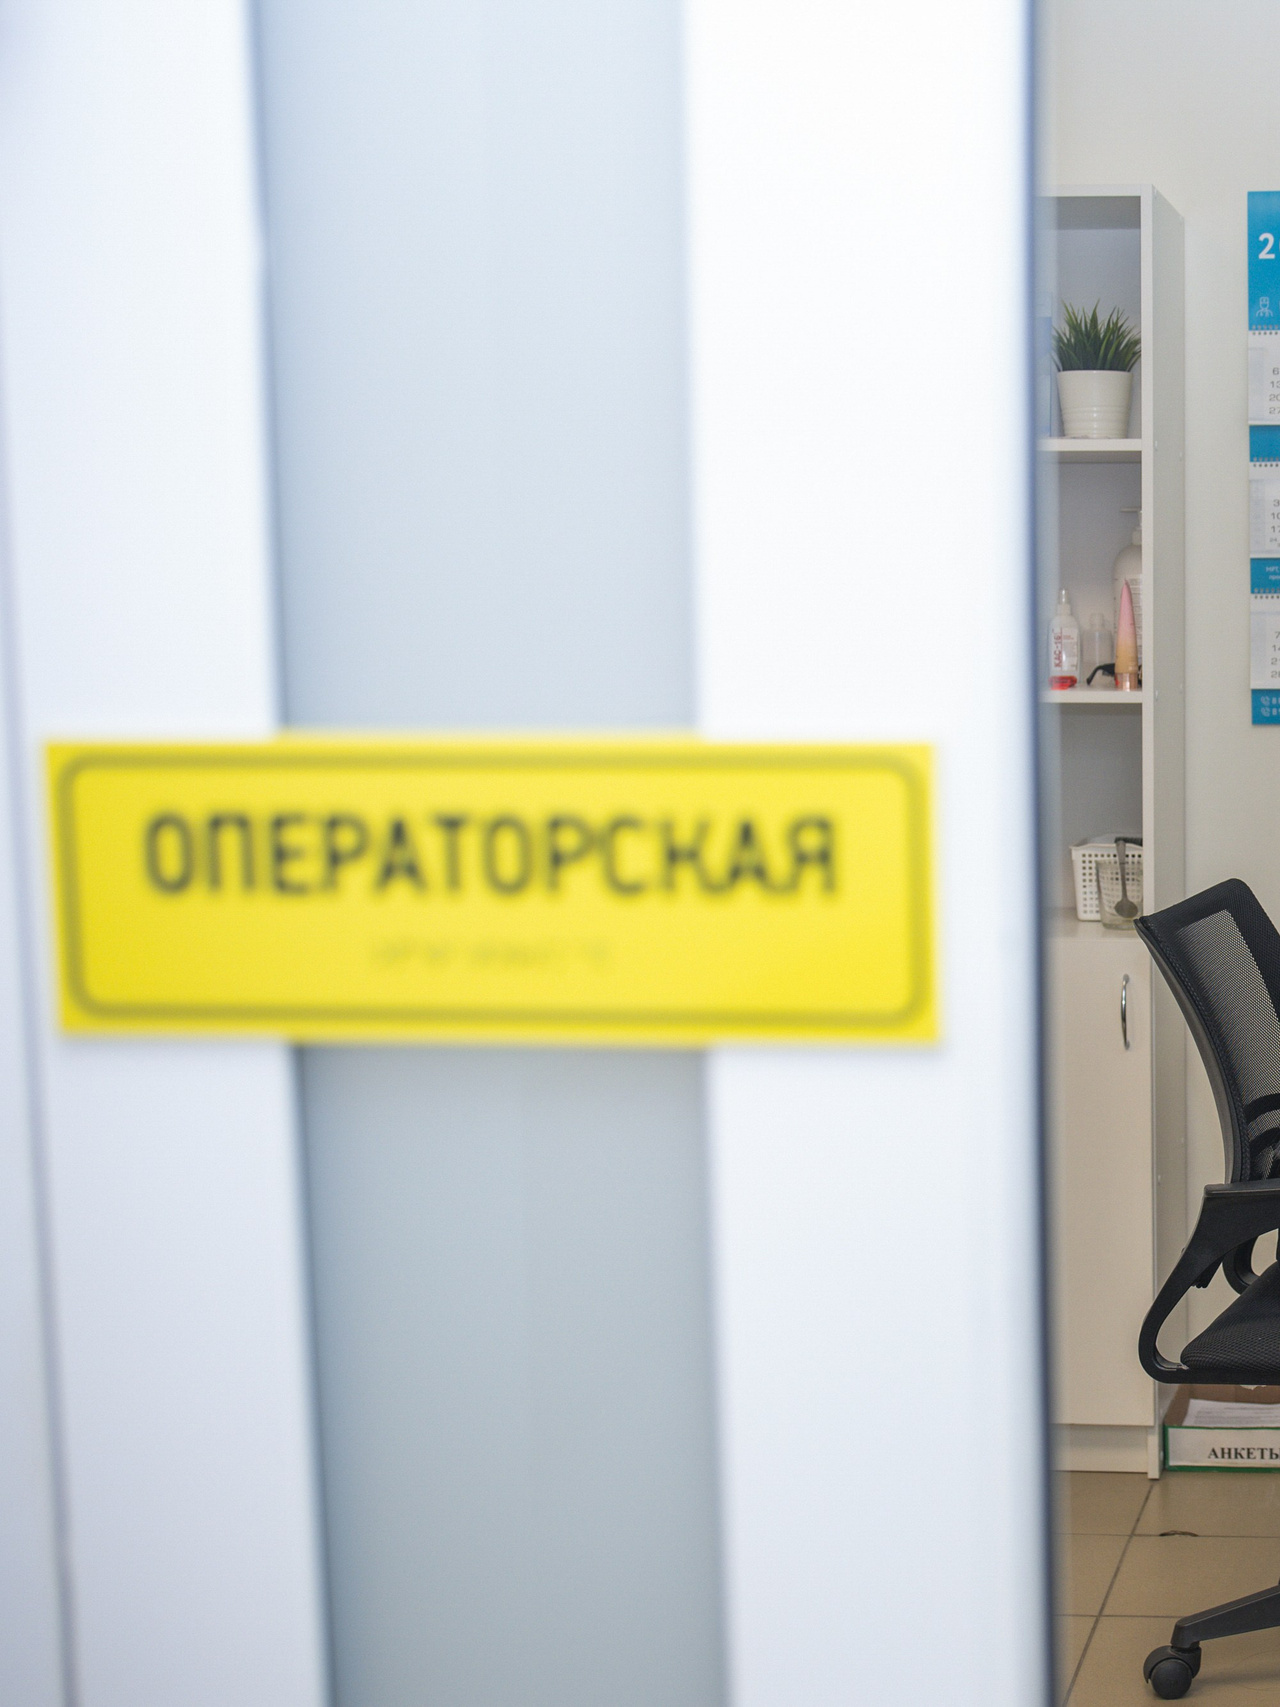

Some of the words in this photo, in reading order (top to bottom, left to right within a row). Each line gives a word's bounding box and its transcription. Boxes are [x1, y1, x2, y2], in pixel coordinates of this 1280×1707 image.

[1273, 367, 1279, 375] 6
[1273, 499, 1280, 507] 3
[1274, 631, 1280, 639] 7
[143, 809, 841, 897] ОПЕРАТОРСКАЯ
